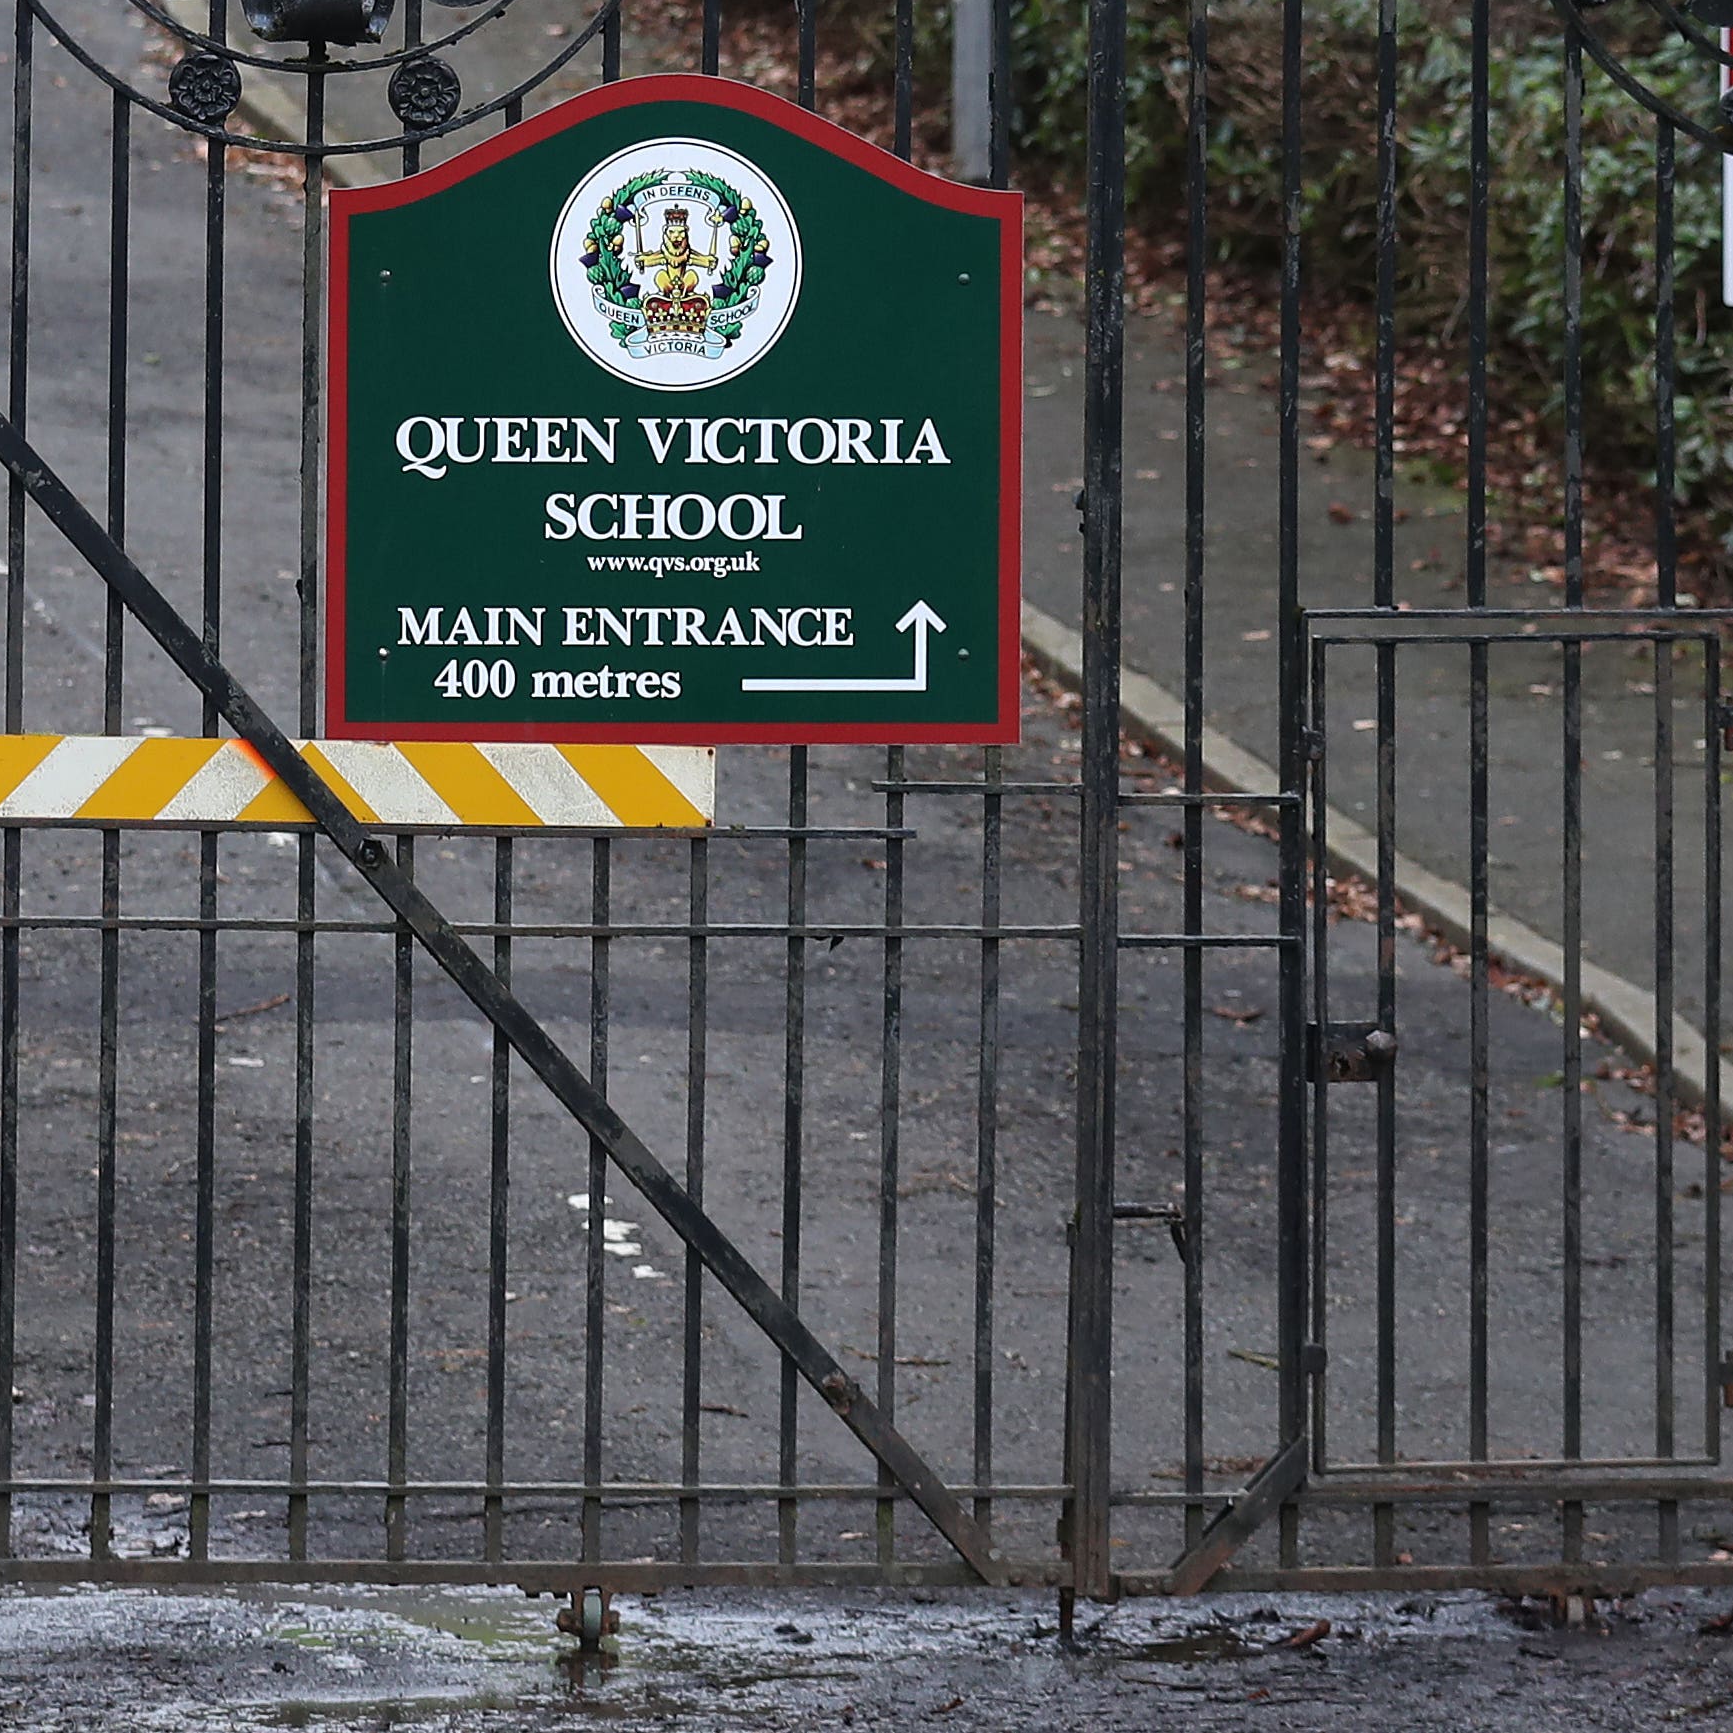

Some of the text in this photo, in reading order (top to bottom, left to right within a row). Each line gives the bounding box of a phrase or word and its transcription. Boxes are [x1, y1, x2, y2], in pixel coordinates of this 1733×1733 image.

[643, 185, 711, 201] IN DEFENS
[599, 304, 641, 324] QUEEN
[710, 305, 755, 325] SCHOOL
[644, 341, 707, 356] VICTORIA
[395, 416, 951, 480] QUEEN VICTORIA
[545, 493, 803, 541] SCHOOL
[587, 551, 761, 578] www.qvs.org.uk
[397, 607, 854, 646] MAIN ENTRANCE
[434, 659, 682, 699] 400 metres
